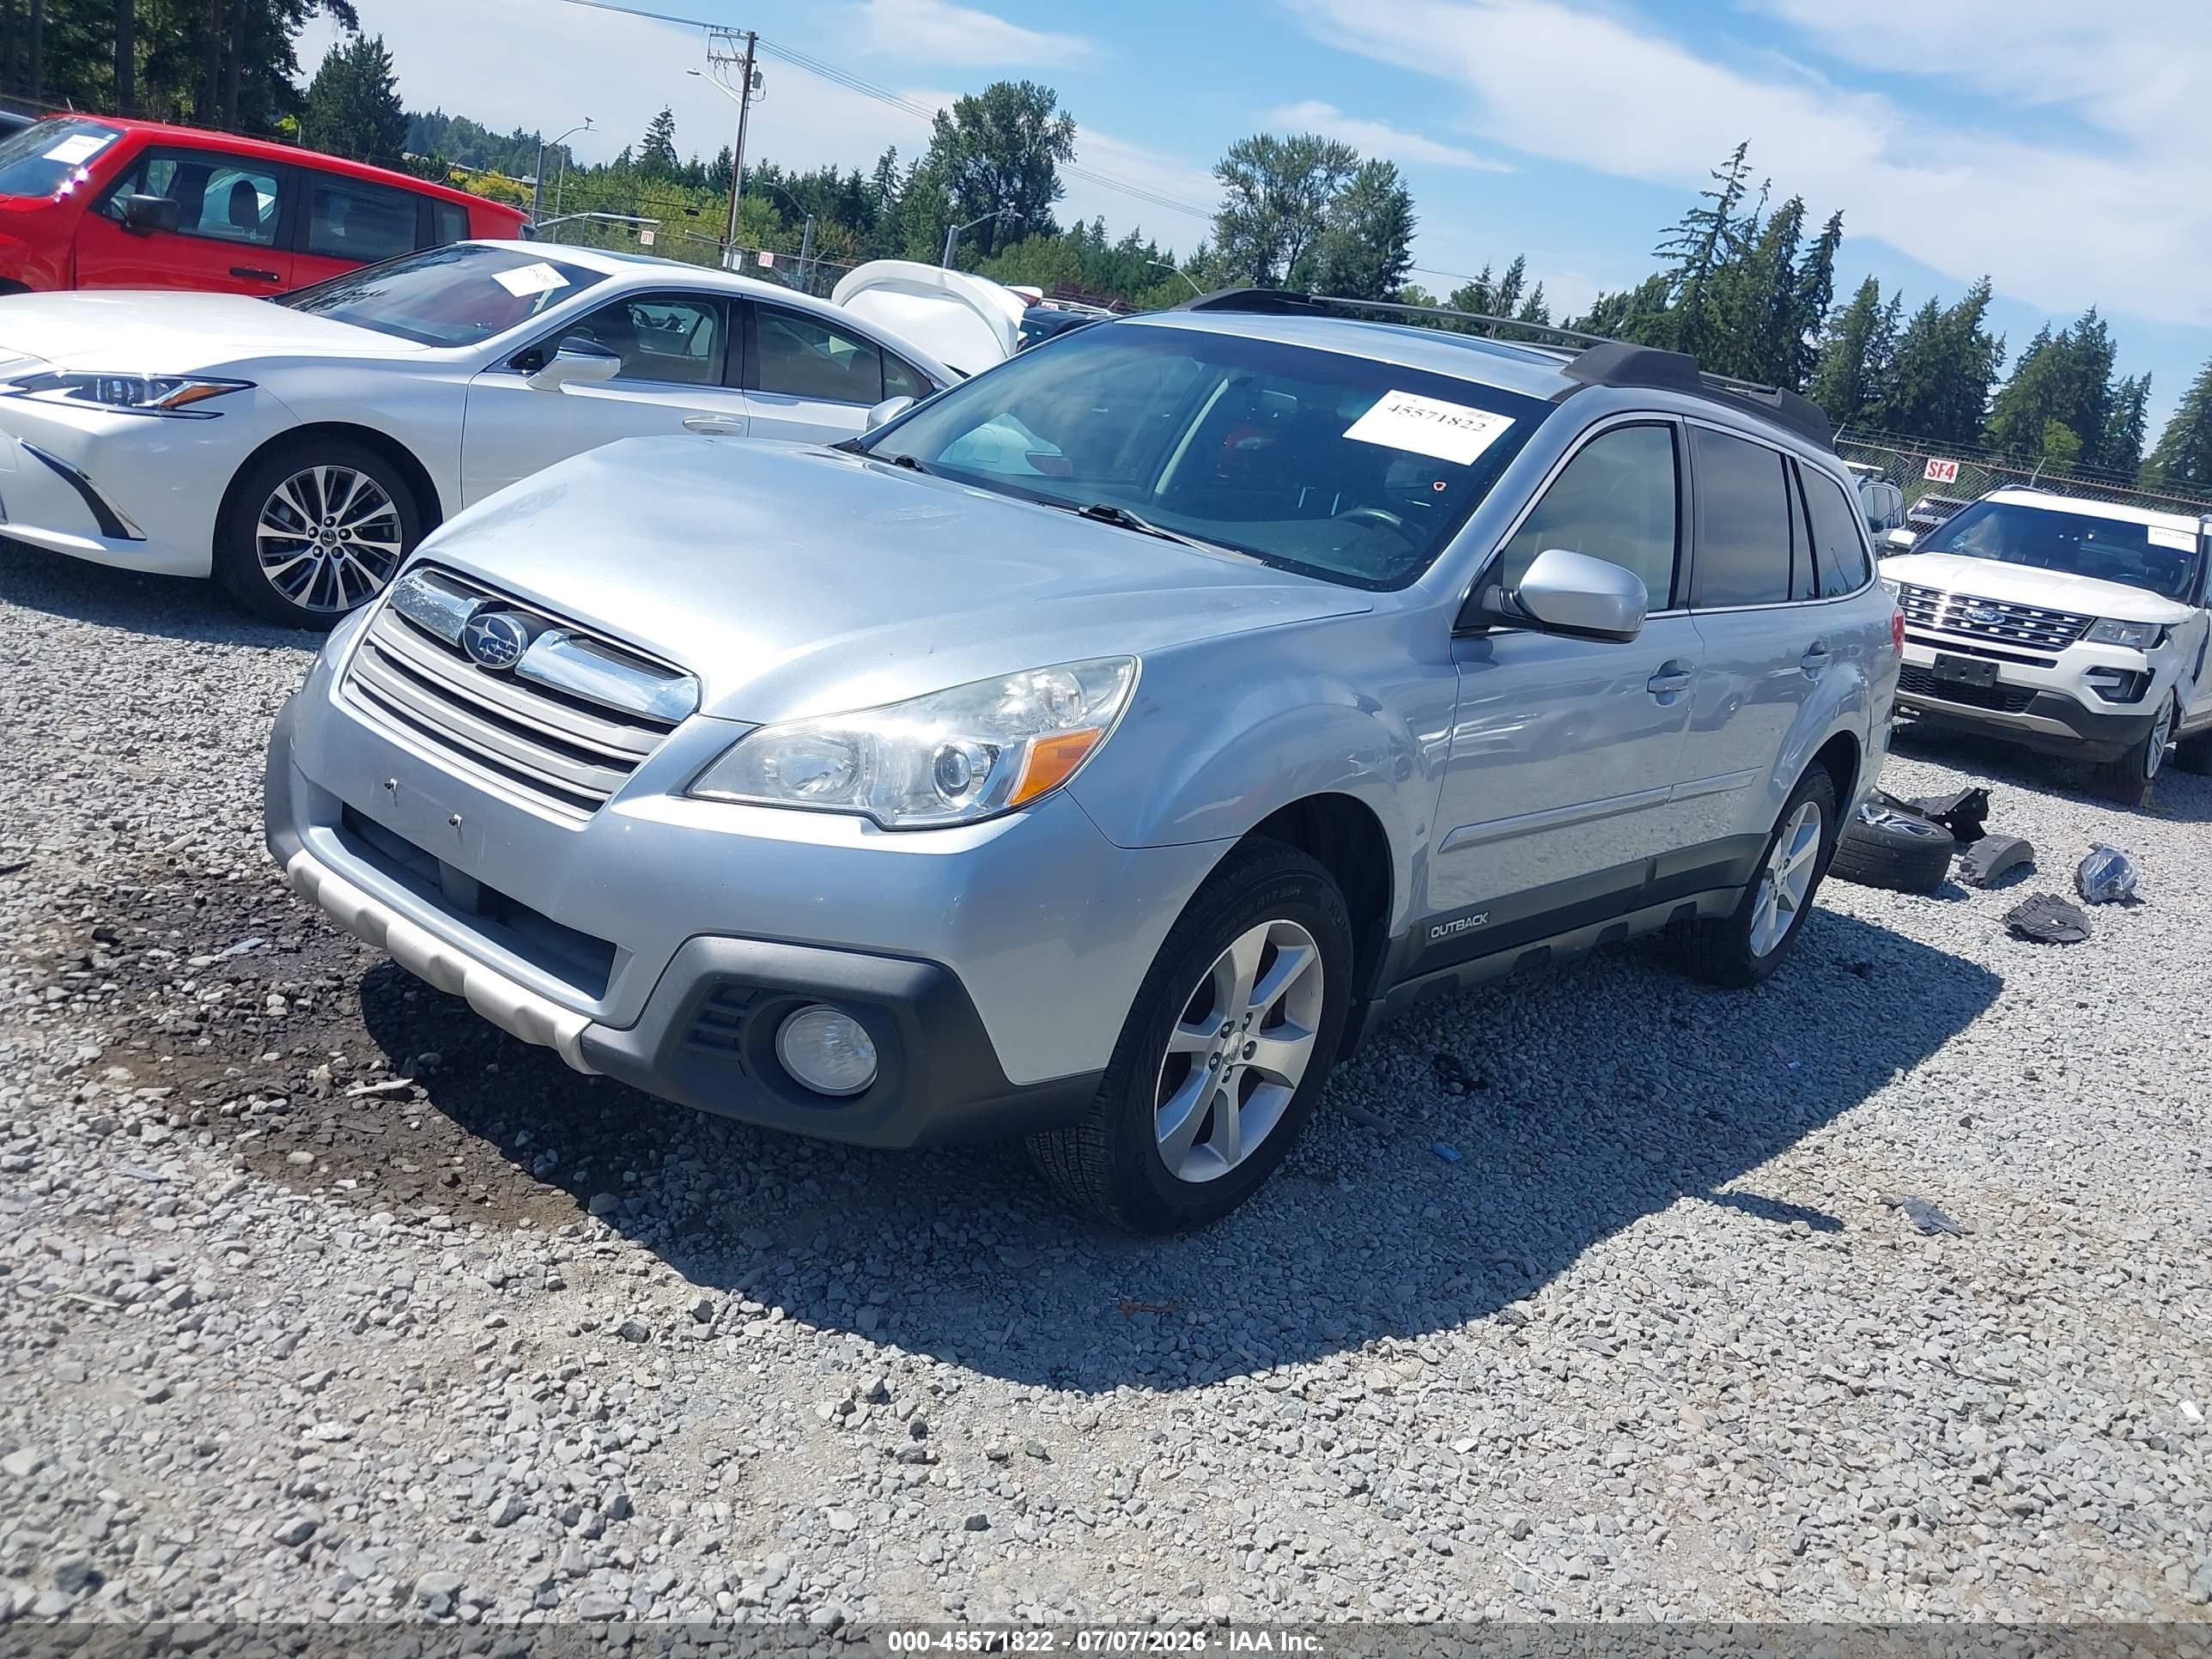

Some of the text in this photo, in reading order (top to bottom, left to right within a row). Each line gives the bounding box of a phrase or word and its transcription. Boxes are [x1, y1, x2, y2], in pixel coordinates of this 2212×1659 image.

[1388, 404, 1486, 432] 45571822
[1928, 461, 1955, 480] SF4
[1431, 912, 1488, 939] OUTBACK
